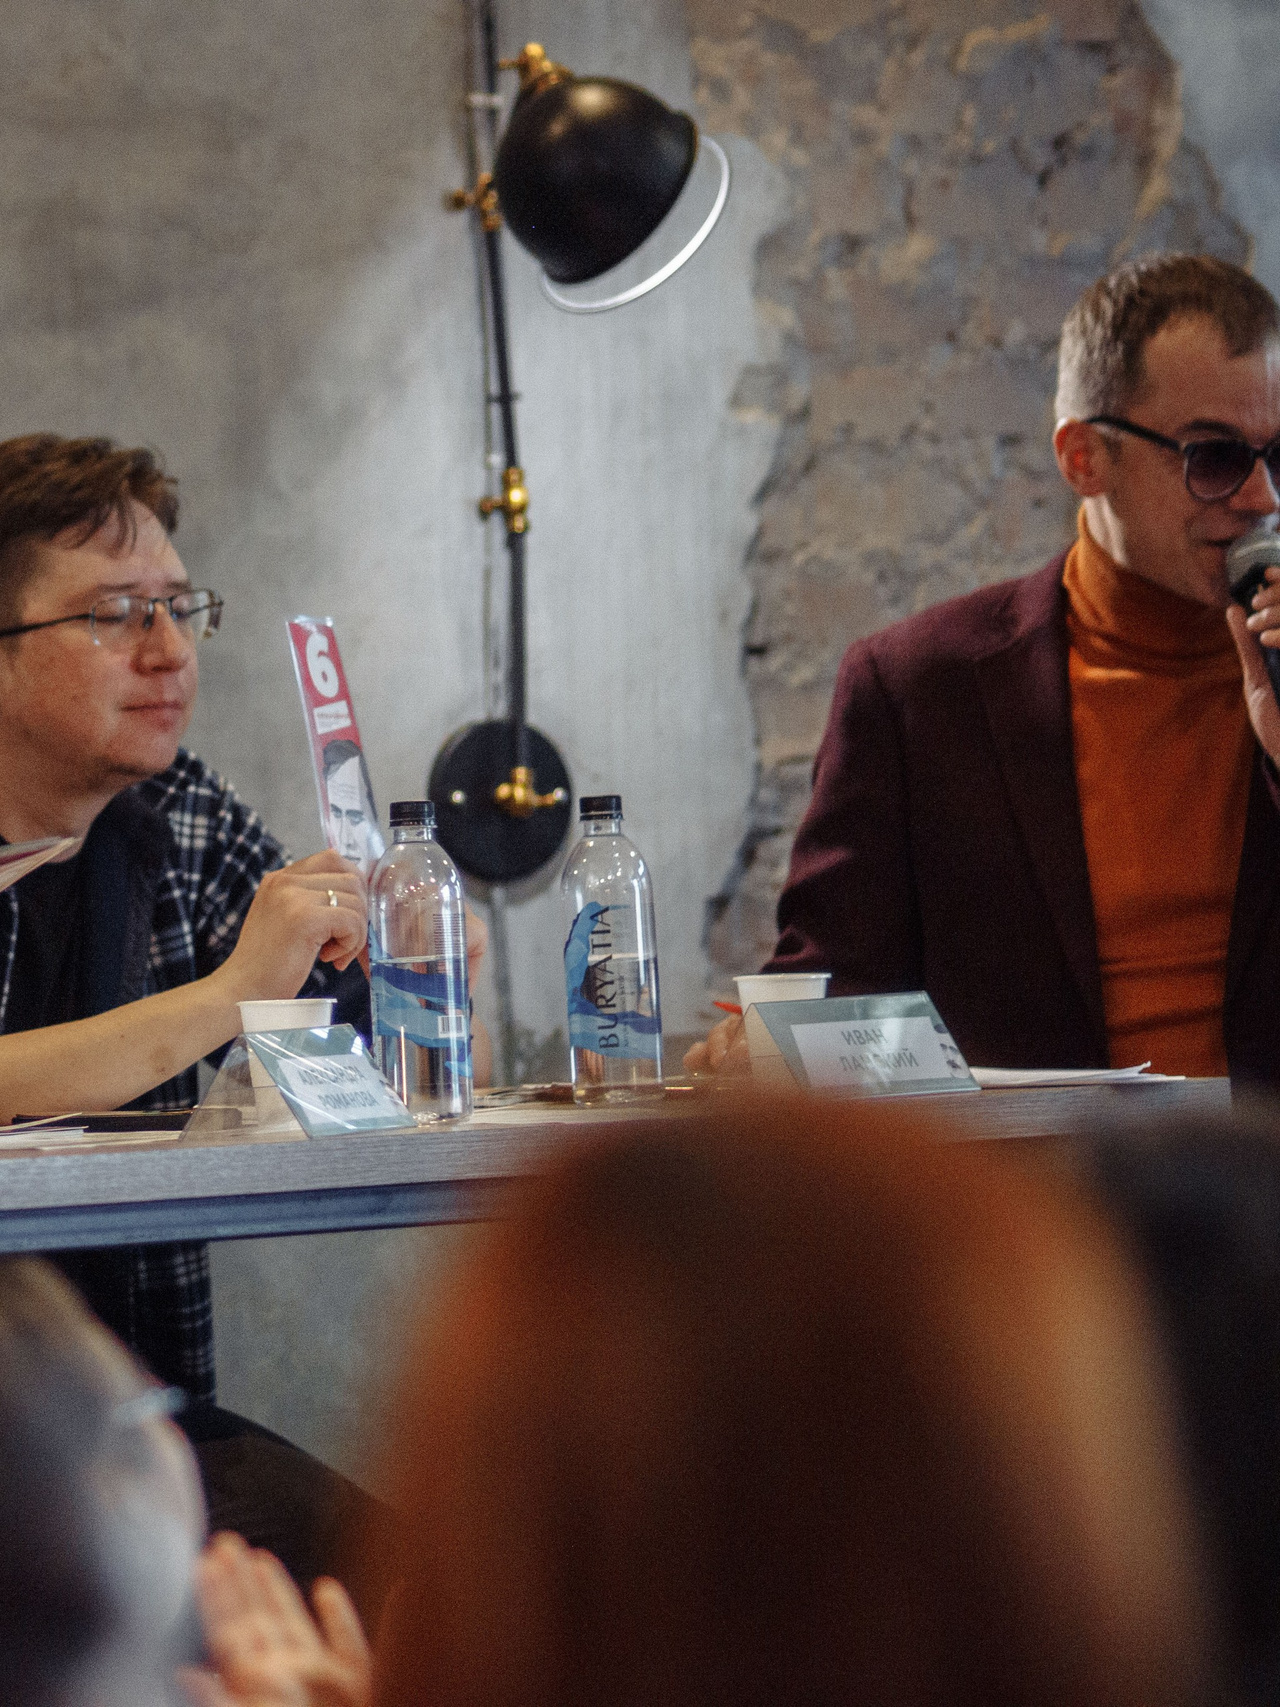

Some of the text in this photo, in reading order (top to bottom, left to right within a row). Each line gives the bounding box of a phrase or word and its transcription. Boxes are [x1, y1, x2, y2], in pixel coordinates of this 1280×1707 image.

[306, 632, 339, 698] 6
[589, 906, 620, 1049] BURYATIA
[841, 1028, 888, 1046] ИВАН
